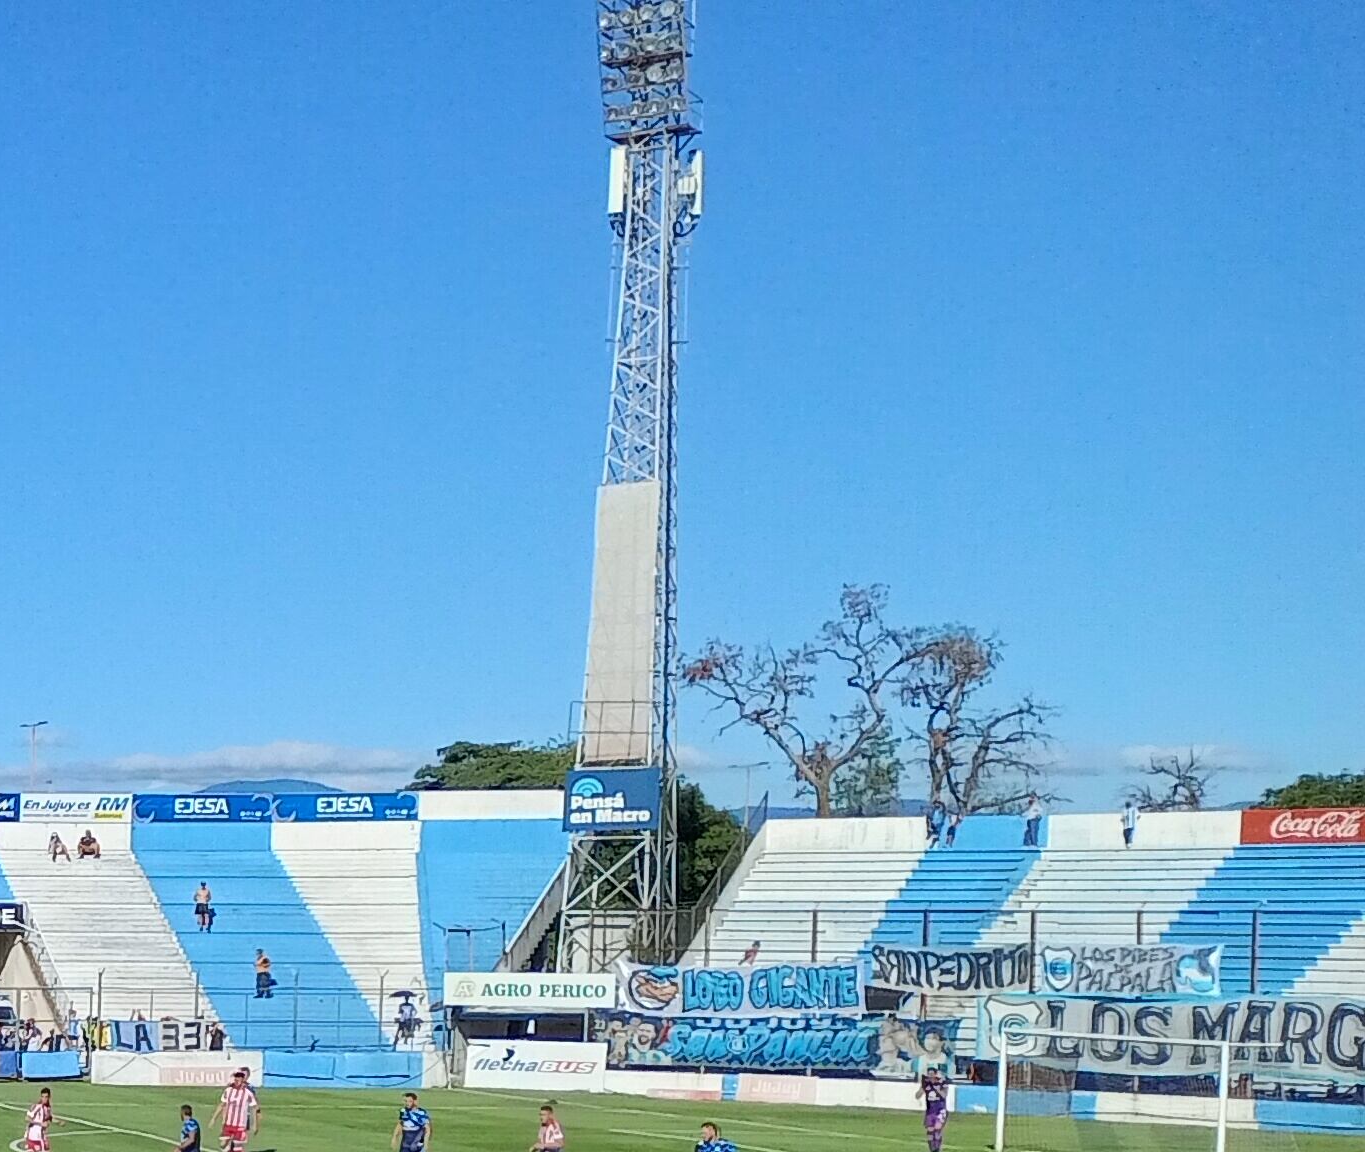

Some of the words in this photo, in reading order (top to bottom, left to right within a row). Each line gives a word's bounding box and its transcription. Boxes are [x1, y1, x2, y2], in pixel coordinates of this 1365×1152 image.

[23, 799, 40, 810] En
[41, 799, 77, 812] Jujuy
[77, 801, 92, 810] es
[95, 797, 130, 811] RM
[570, 791, 625, 810] Pensá
[570, 811, 593, 824] en
[595, 808, 651, 824] Macro
[481, 983, 532, 998] AGRO
[539, 984, 607, 998] PERICO
[749, 964, 859, 1011] GIGANTE
[115, 1021, 154, 1051] LA
[1046, 1000, 1173, 1065] LOS
